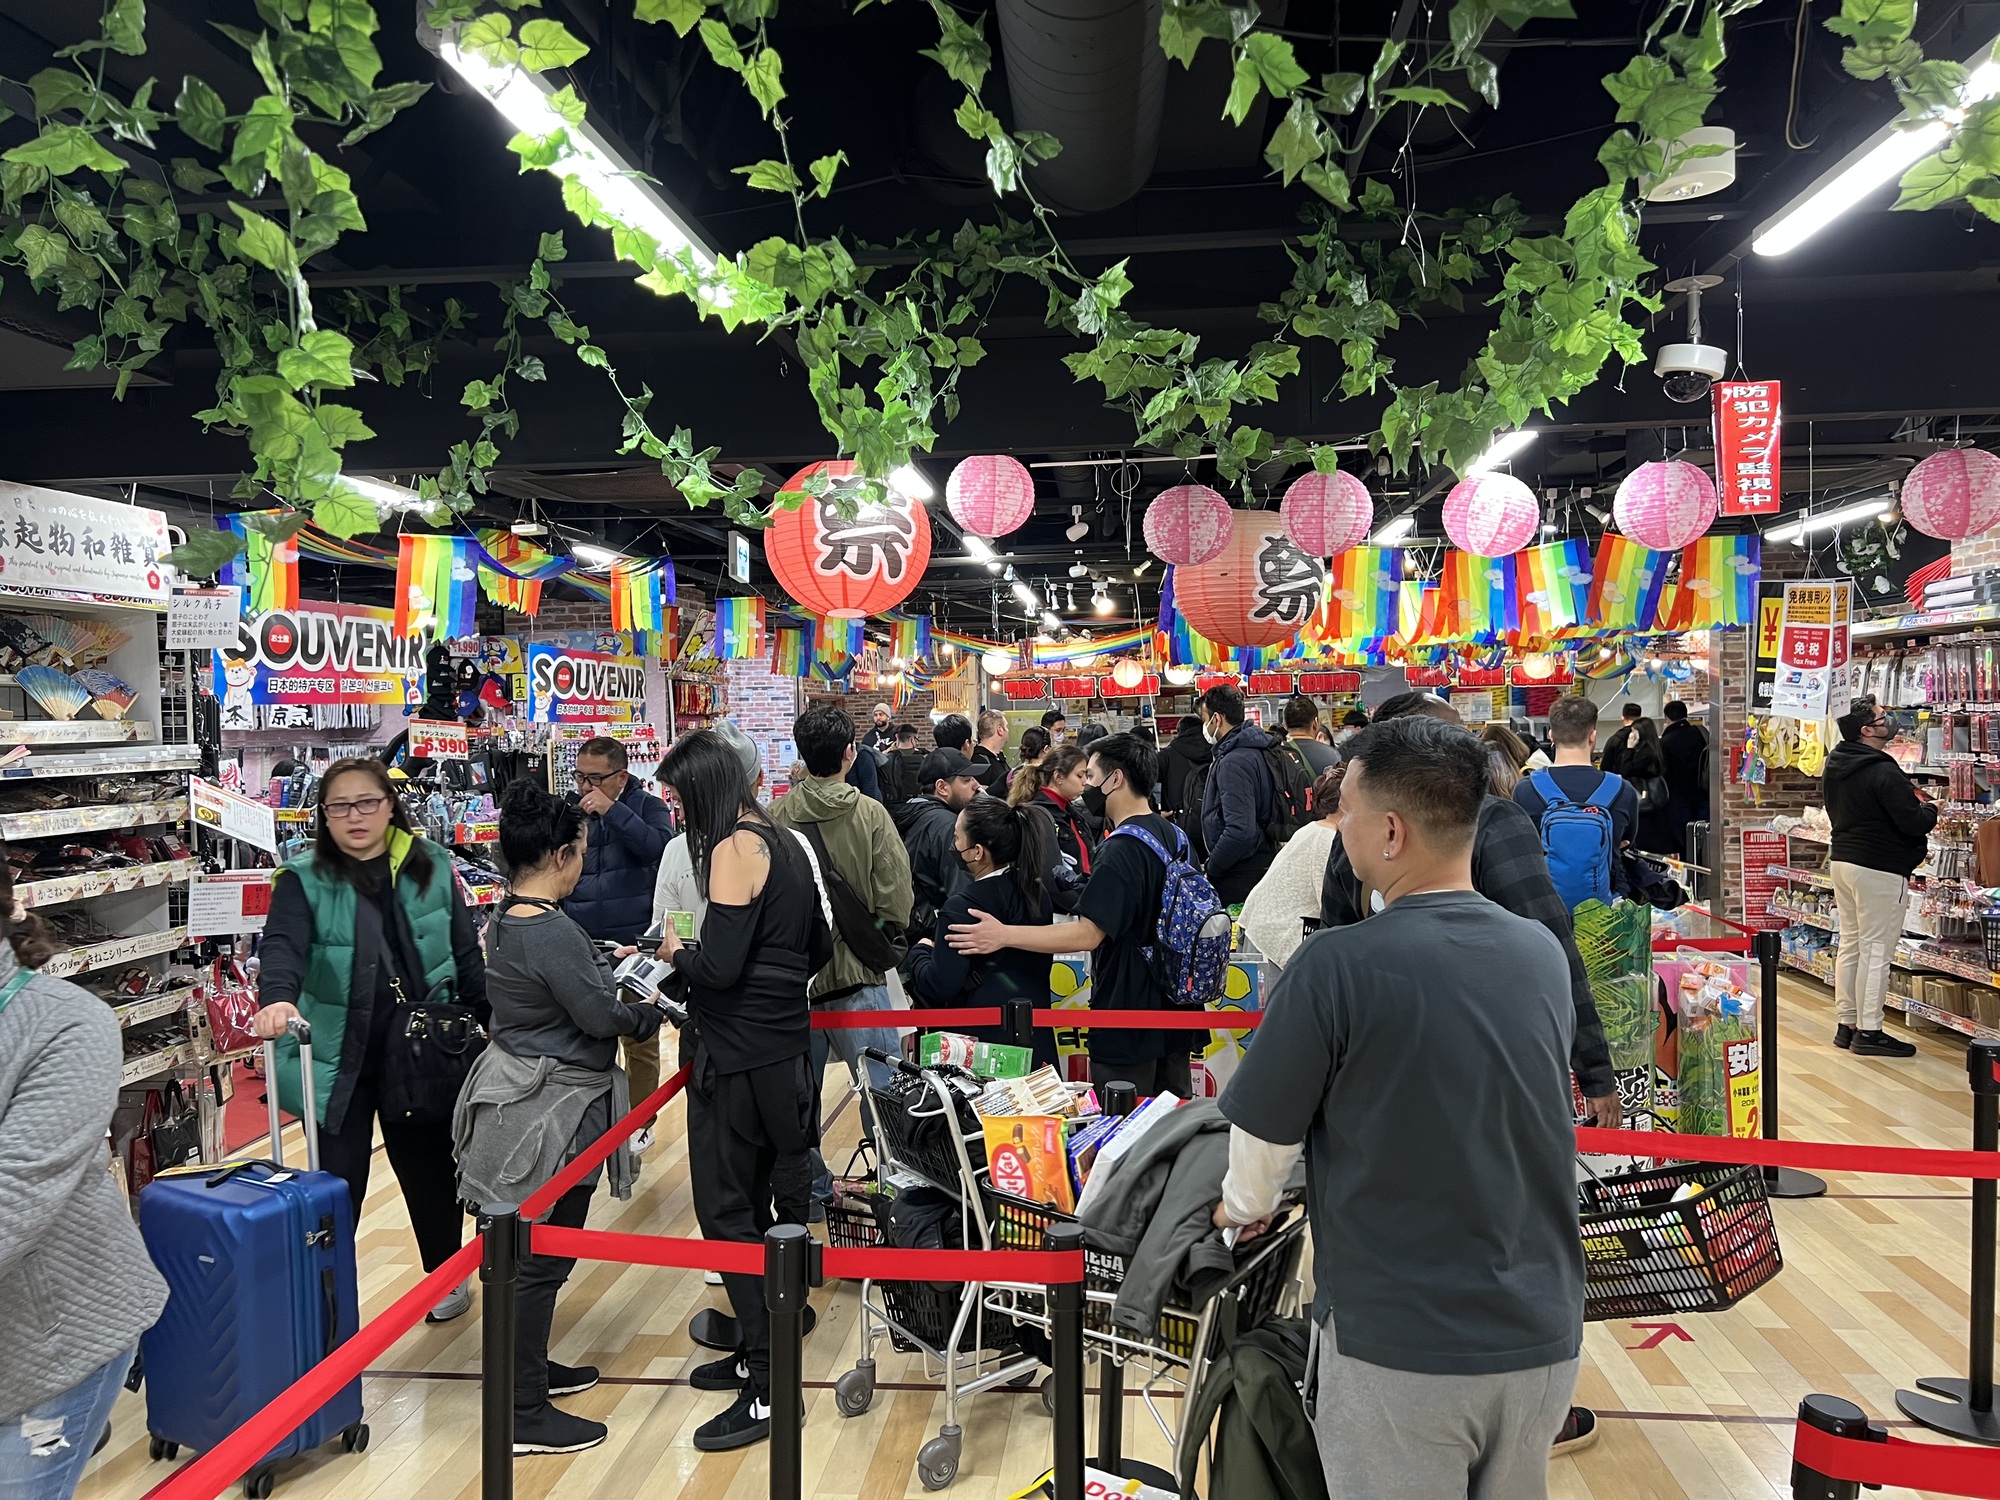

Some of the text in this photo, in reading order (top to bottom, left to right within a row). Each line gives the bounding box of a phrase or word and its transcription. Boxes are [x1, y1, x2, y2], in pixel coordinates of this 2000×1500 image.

[1732, 386, 1772, 506] 防犯カメラ監視中
[819, 476, 912, 580] 祭
[1253, 534, 1326, 622] 祭
[535, 657, 645, 699] SOUVENIR
[1793, 657, 1817, 666] Tax Free
[1004, 680, 1046, 699] TAX
[425, 738, 468, 754] 6,990
